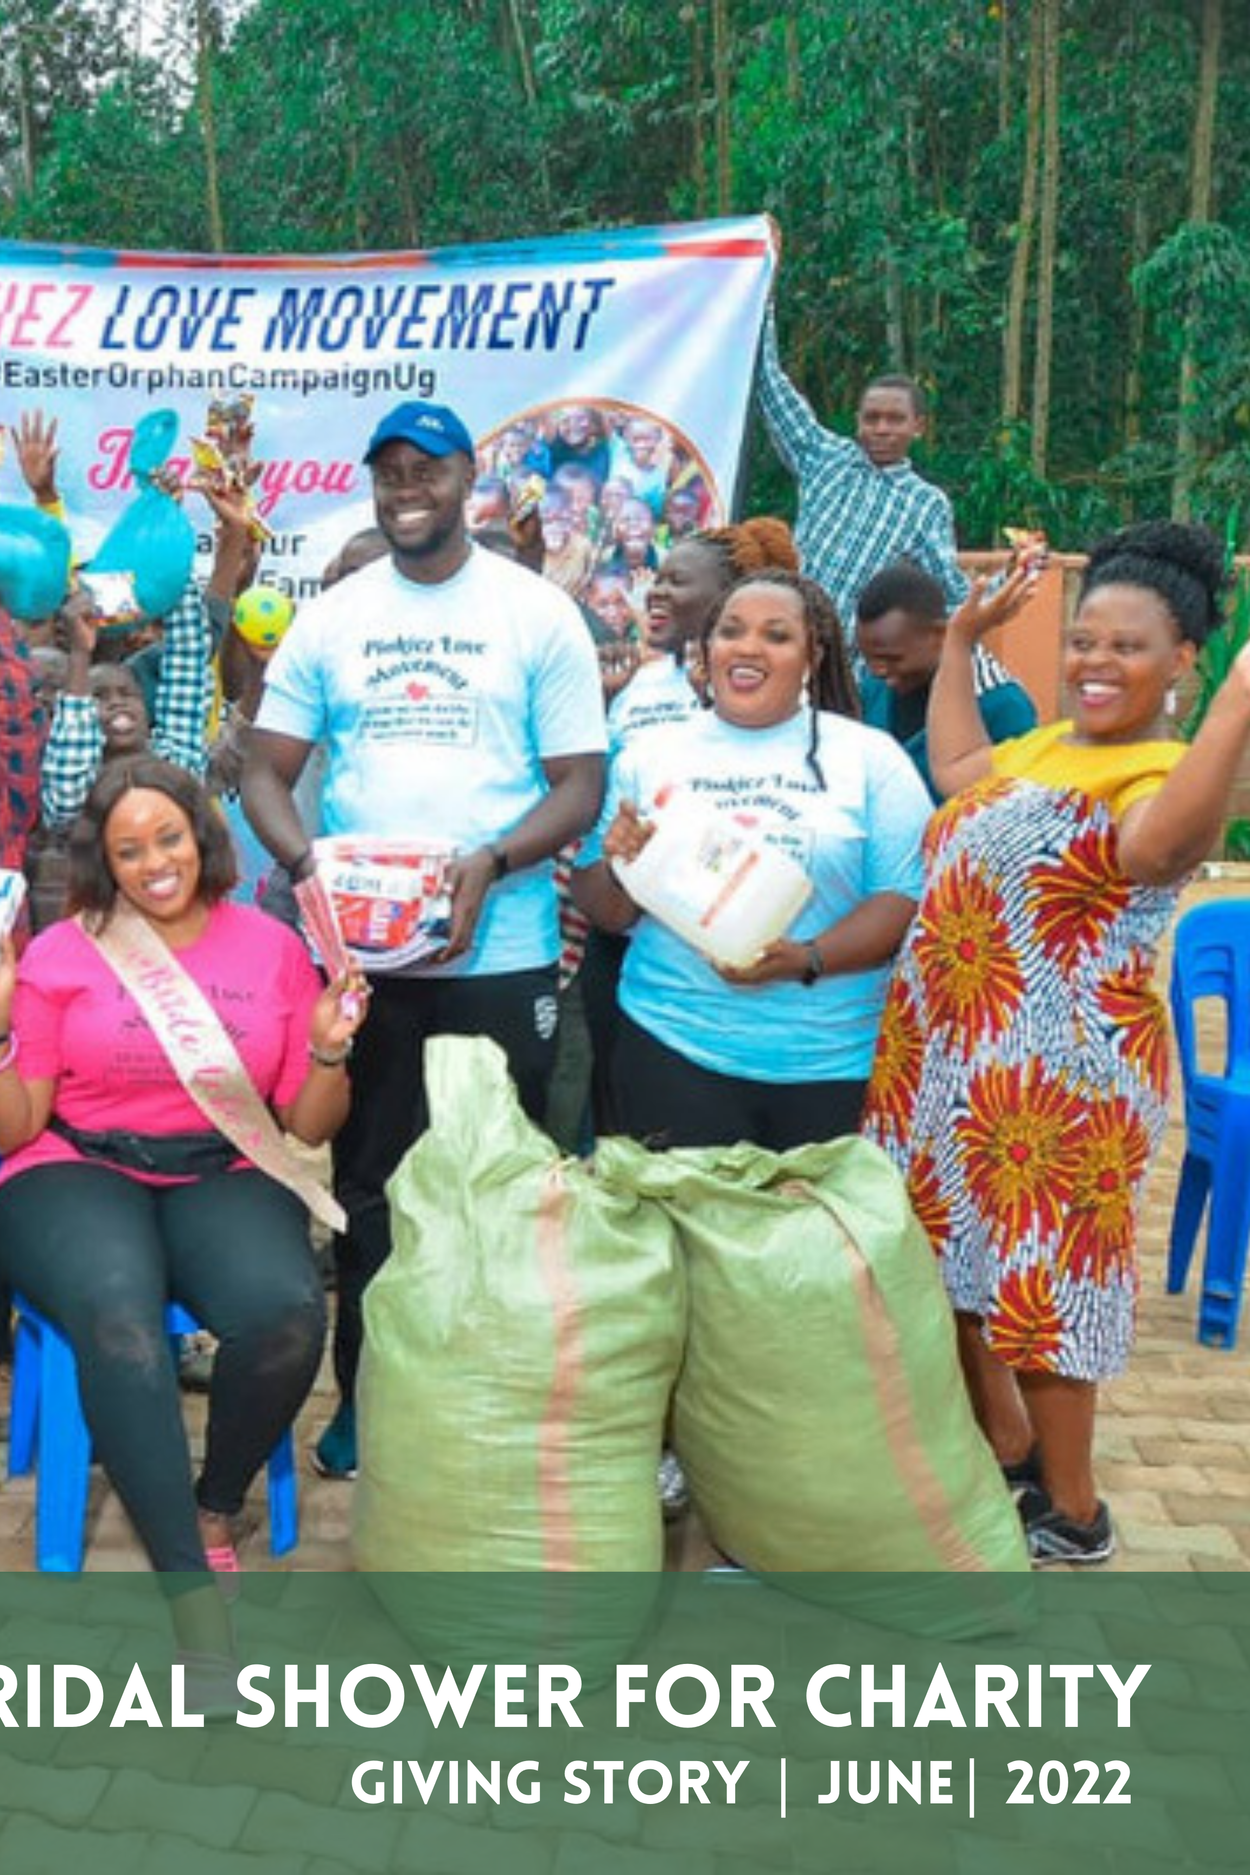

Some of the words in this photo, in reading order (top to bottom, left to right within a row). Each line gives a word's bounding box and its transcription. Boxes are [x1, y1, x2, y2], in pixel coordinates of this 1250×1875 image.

[100, 284, 256, 352] LOVE
[263, 278, 616, 352] MOVEMENT
[257, 458, 357, 517] you
